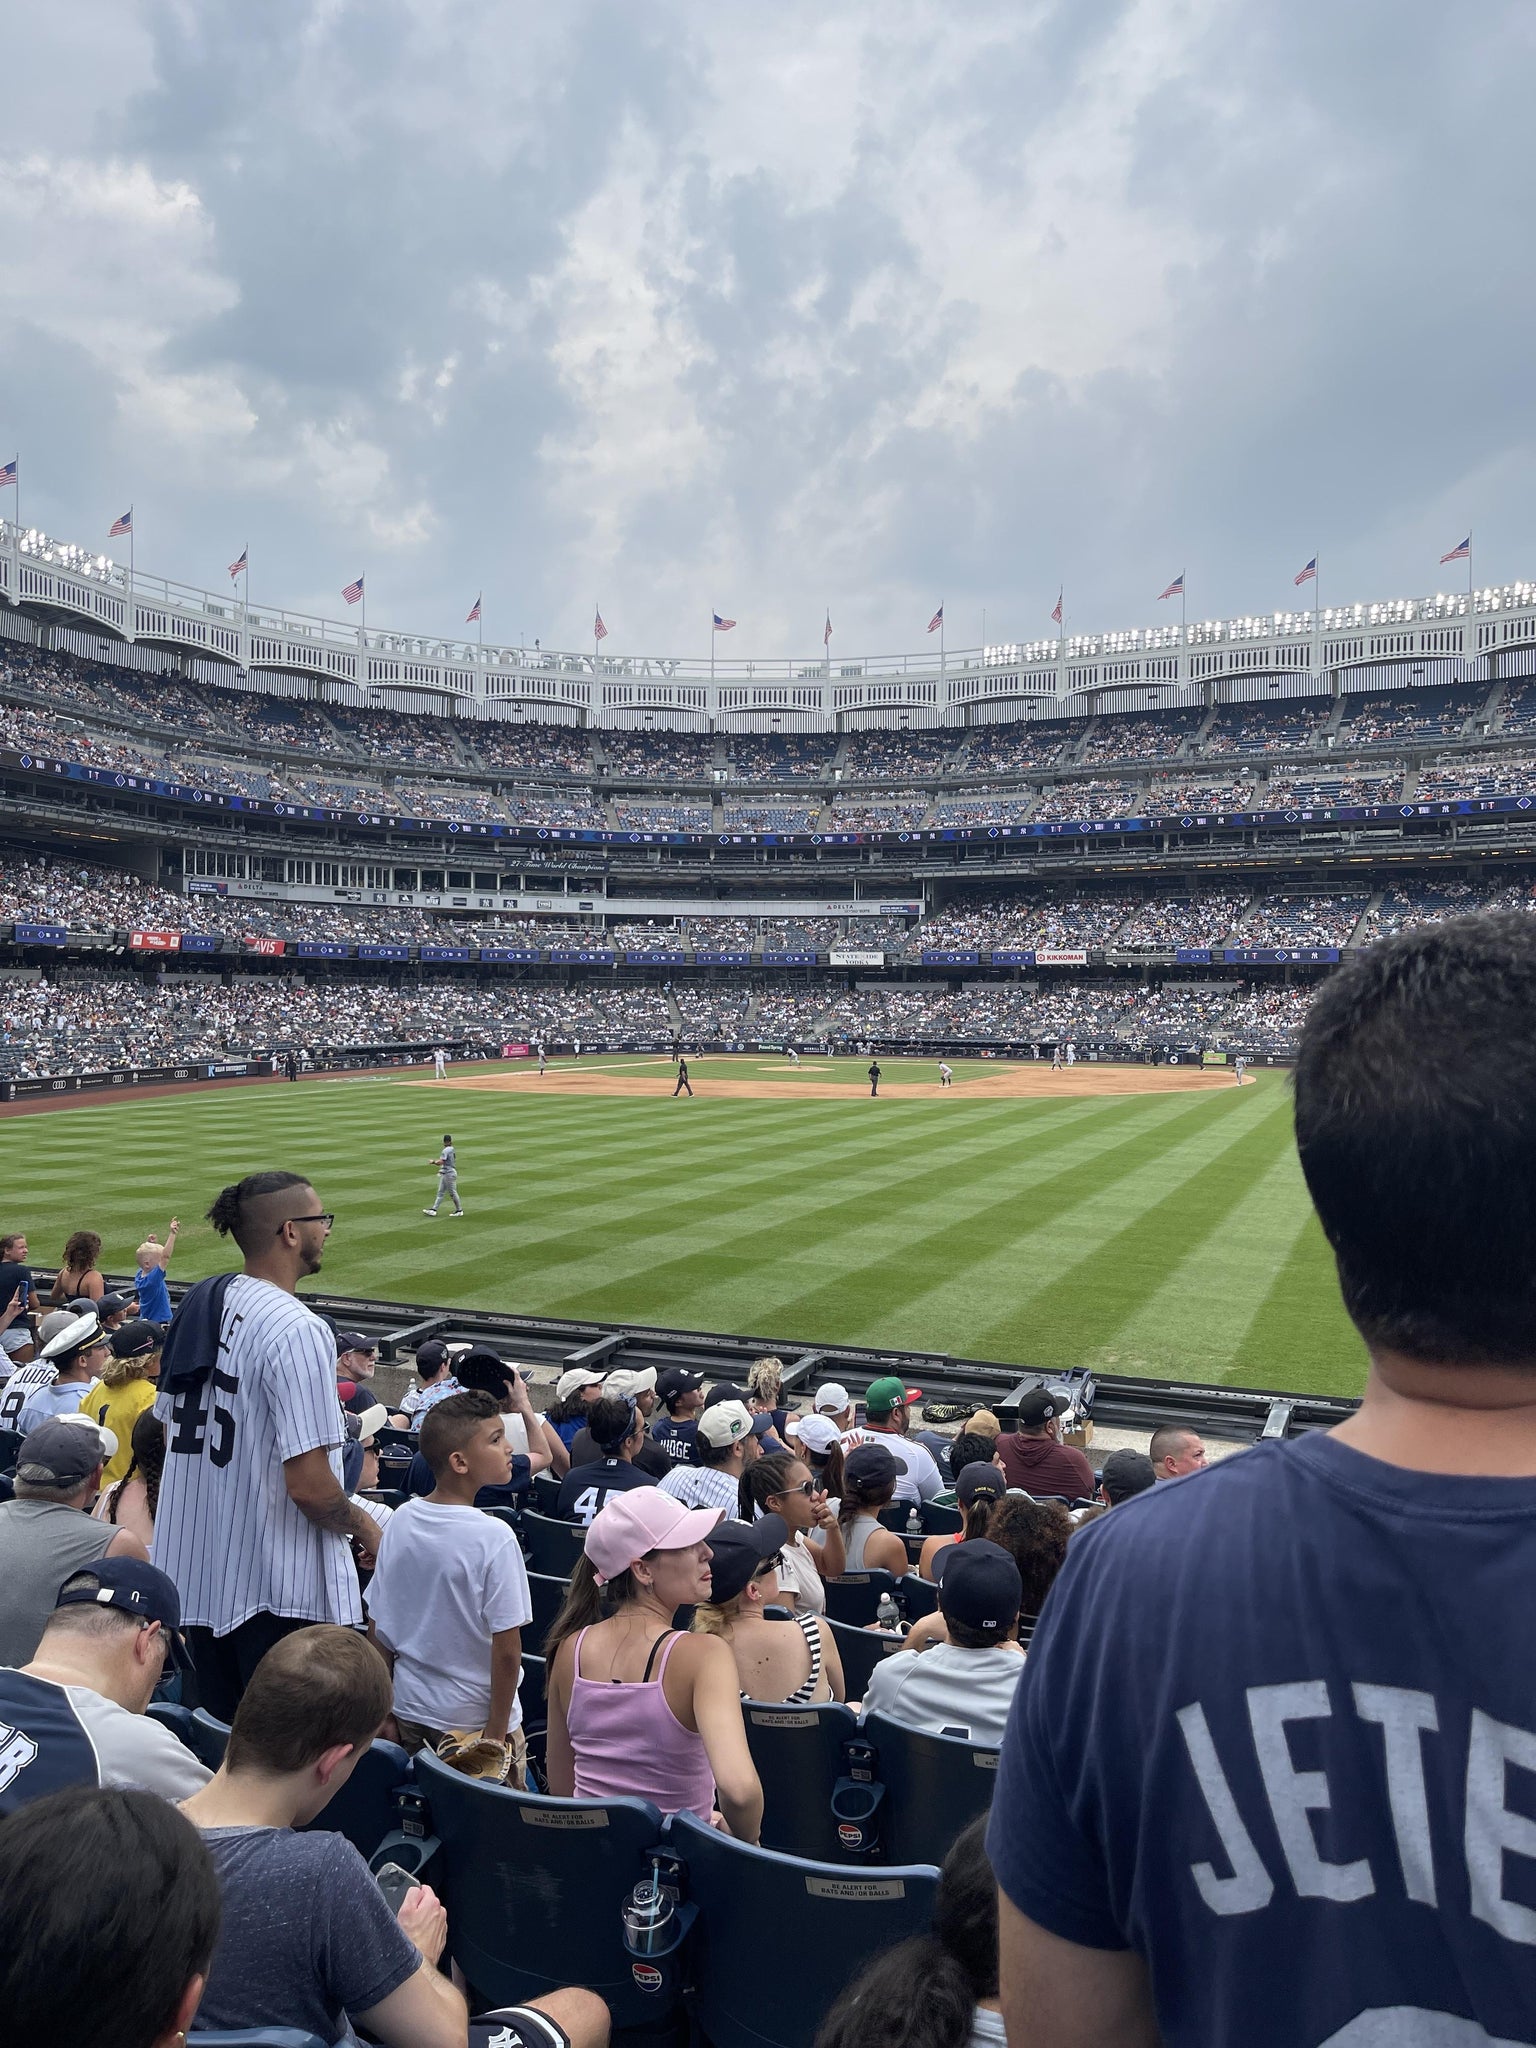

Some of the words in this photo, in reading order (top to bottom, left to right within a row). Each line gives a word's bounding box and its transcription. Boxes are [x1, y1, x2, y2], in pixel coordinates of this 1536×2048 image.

[509, 860, 542, 868] 27-Time
[543, 861, 567, 869] World
[567, 863, 605, 872] Champions
[254, 940, 275, 954] AVIS
[14, 1367, 60, 1386] JUDG
[0, 1391, 26, 1430] 9
[660, 1439, 692, 1460] UDGE
[839, 1830, 862, 1839] PEPSI
[820, 1887, 839, 1895] BATS
[633, 1970, 660, 1982] PEPSI
